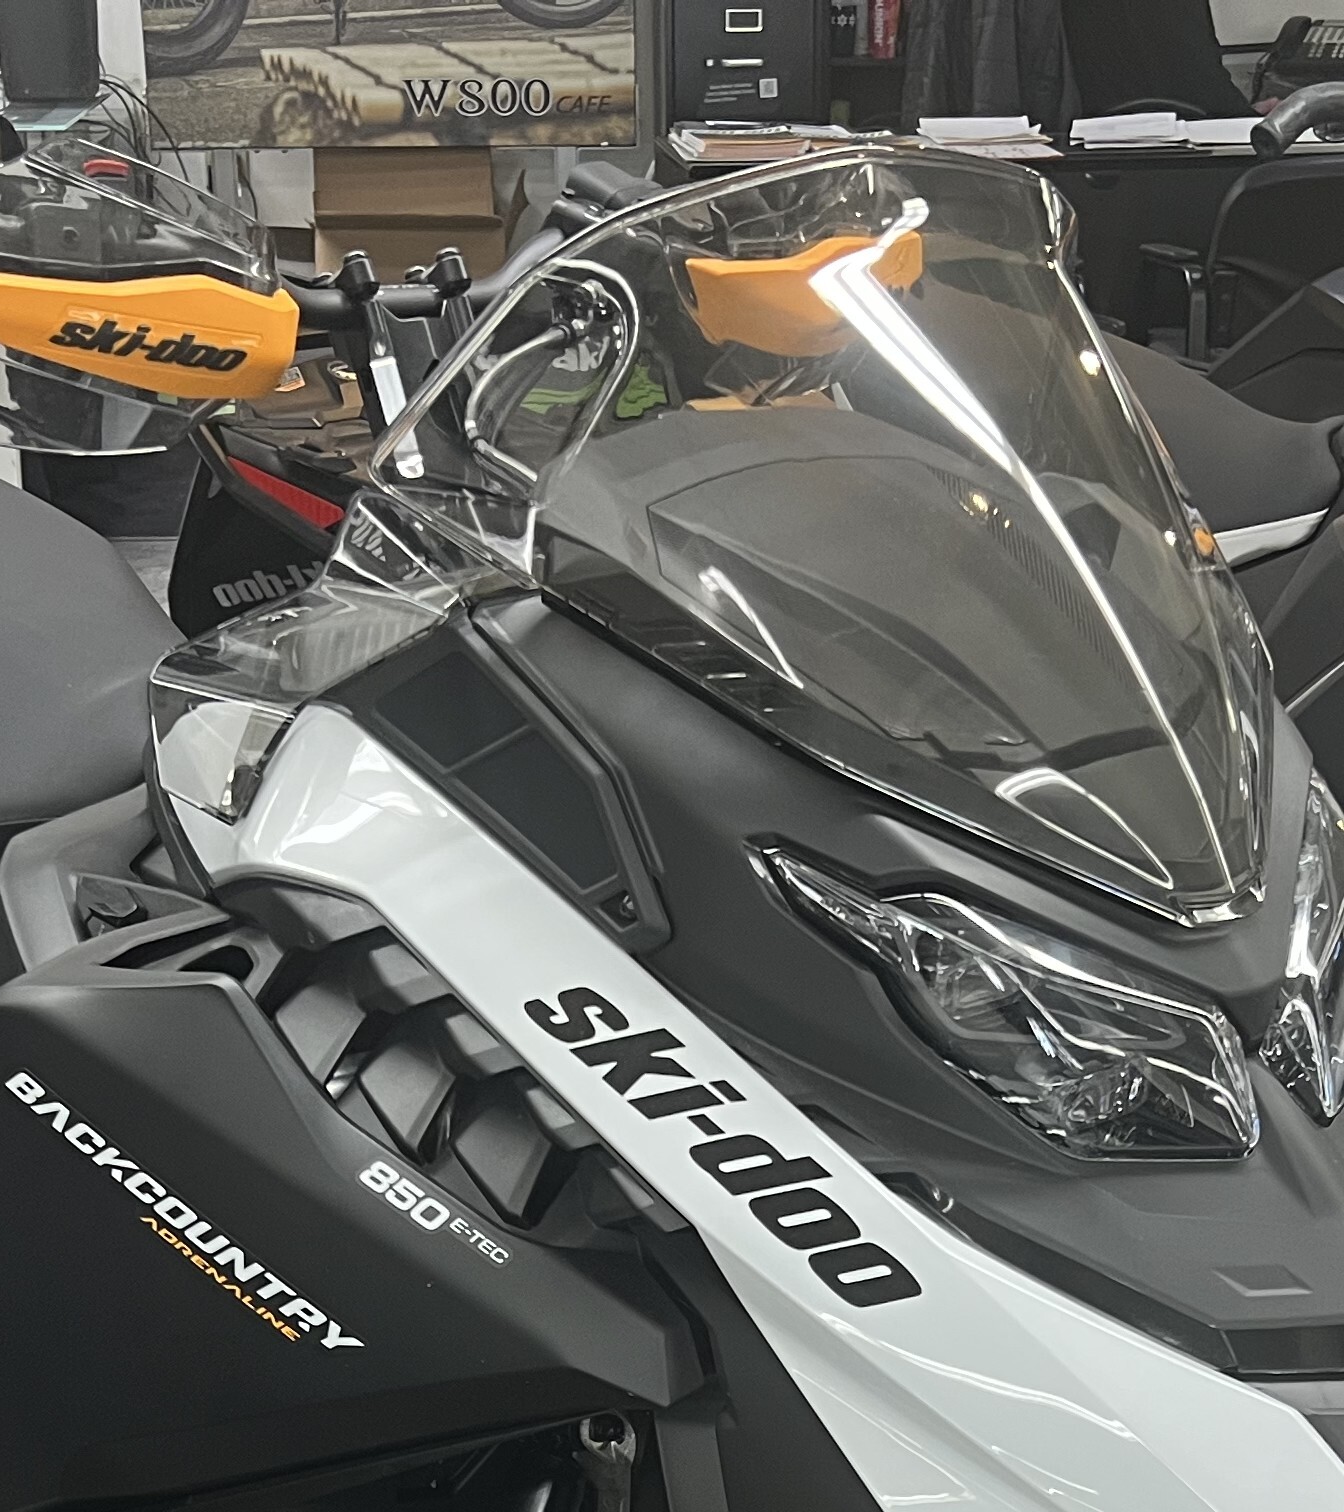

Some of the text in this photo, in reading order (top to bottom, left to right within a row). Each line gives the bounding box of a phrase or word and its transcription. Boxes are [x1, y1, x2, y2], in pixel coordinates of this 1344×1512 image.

[48, 318, 249, 372] ski-doo
[4, 1071, 365, 1350] BACKCOUNTRY
[523, 986, 923, 1308] ski-doo
[358, 1160, 510, 1265] 850 E-TEC
[139, 1215, 302, 1343] ADRENALINE
